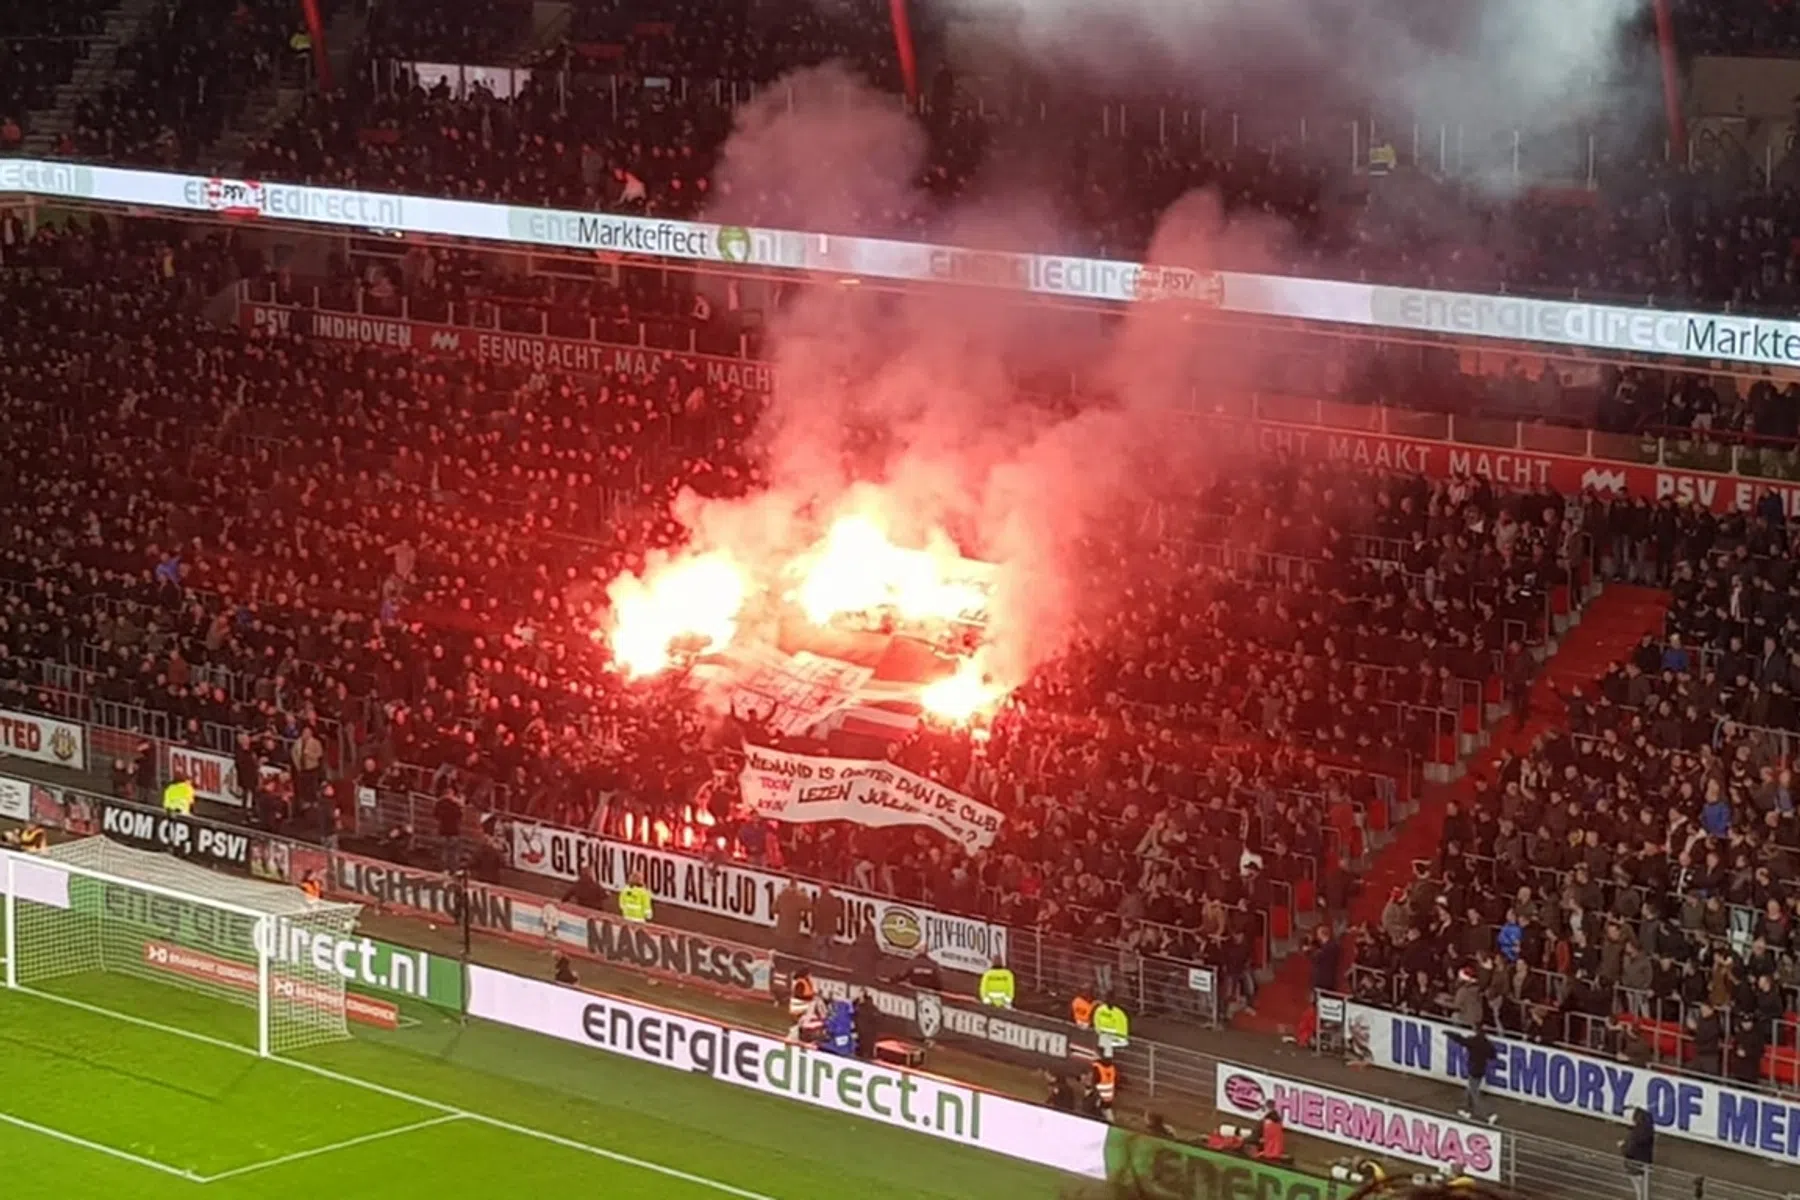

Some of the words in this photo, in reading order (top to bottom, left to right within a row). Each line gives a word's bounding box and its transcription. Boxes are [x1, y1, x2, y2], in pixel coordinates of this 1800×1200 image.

[578, 216, 707, 255] Markteffect
[312, 313, 411, 346] INDHOVEN
[1327, 435, 1431, 473] MAAKT
[1448, 449, 1552, 485] MACHT
[1656, 473, 1717, 507] PSV
[103, 806, 154, 840] KOM
[158, 819, 193, 854] OP,
[198, 828, 248, 862] PSV!
[935, 794, 957, 814] DE
[960, 804, 998, 832] CLUB
[622, 849, 676, 899] VOOR
[684, 863, 756, 917] ALTIJD
[587, 917, 756, 989] MADNESS
[942, 1006, 988, 1038] THE
[582, 1002, 981, 1140] energiedirect.nl
[1391, 1017, 1432, 1070] IN
[1446, 1032, 1635, 1117] MEMORY
[1646, 1076, 1704, 1131] OF
[1274, 1082, 1494, 1174] HERMANAS
